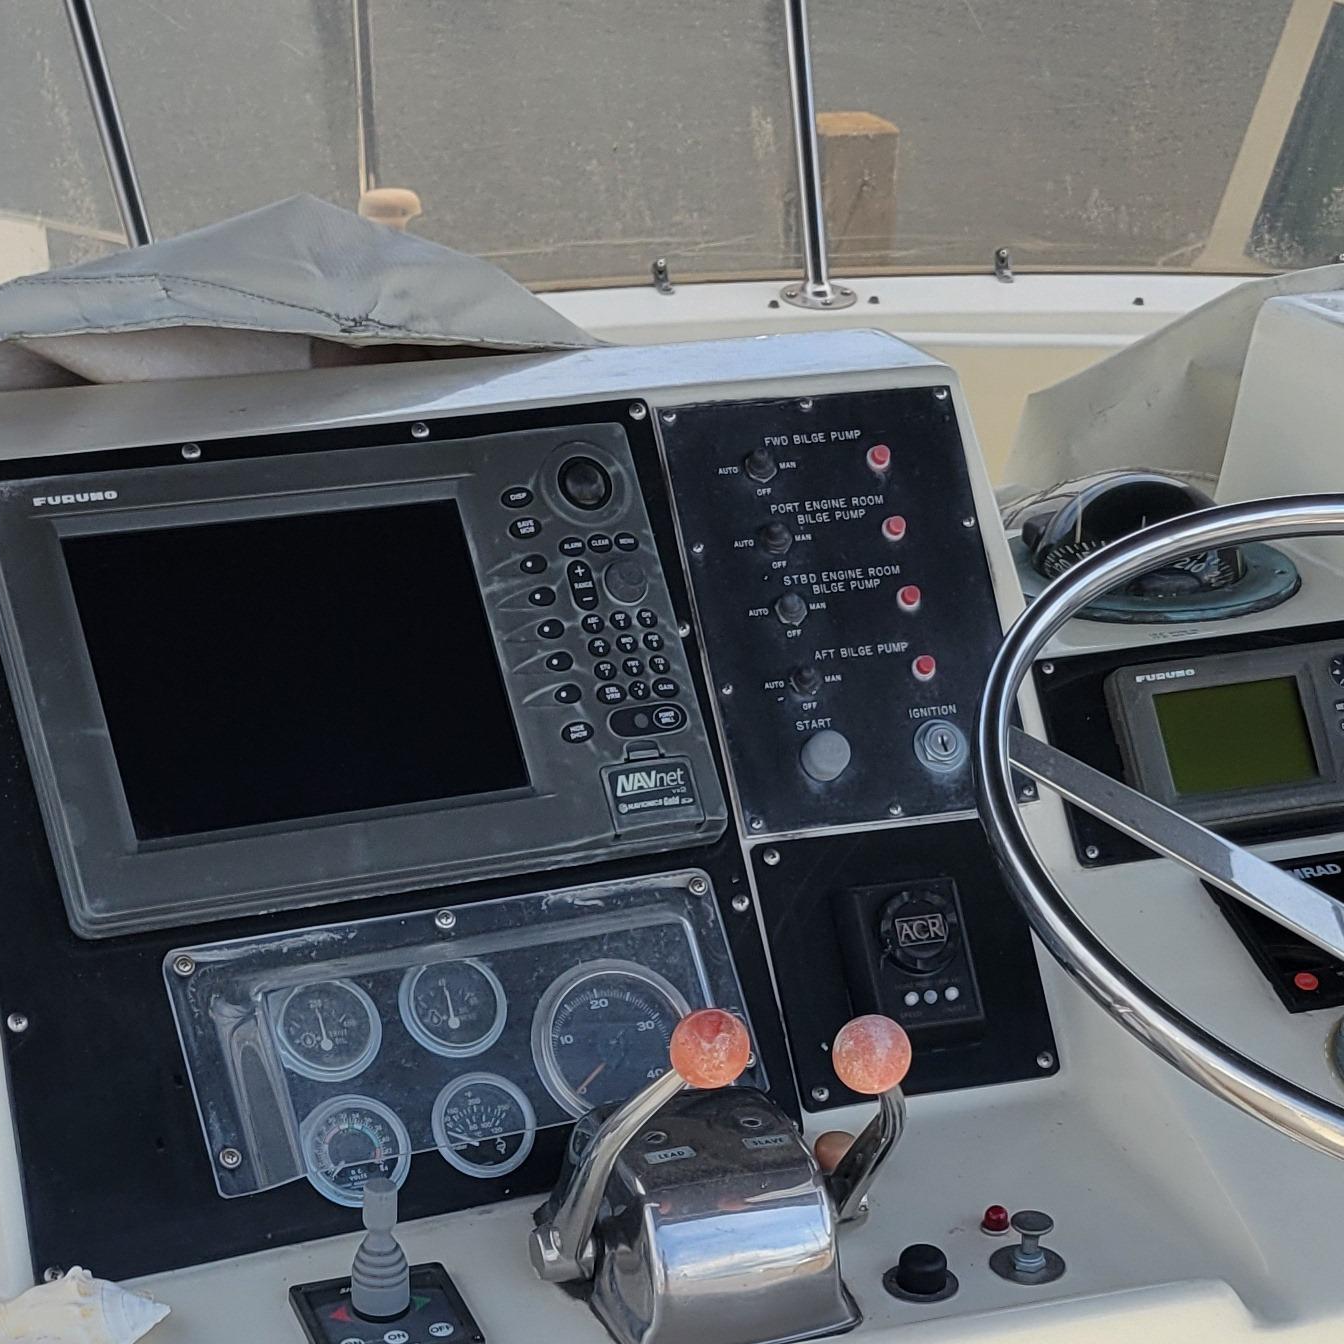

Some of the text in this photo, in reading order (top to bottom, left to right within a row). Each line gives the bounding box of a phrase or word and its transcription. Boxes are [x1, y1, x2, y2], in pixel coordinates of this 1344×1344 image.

[764, 430, 861, 446] FWD BILGE PUMP
[718, 467, 739, 475] AUTO
[756, 488, 772, 496] OFF
[32, 490, 118, 506] FURUNO
[770, 495, 884, 514] PORT ENGINE ROOM
[797, 509, 866, 524] BILGE PUMP
[591, 539, 609, 547] CLEAR
[771, 561, 787, 569] OFF
[1174, 558, 1206, 572] 210
[783, 565, 900, 585] STBD ENGINE ROOM
[812, 579, 881, 594] BILGE PUMP
[809, 602, 826, 610] MAN
[748, 608, 769, 616] AUTO
[787, 629, 802, 637] OFF
[814, 642, 909, 660] AFT BILGE PUMP
[1135, 669, 1195, 682] FURUNO
[764, 681, 785, 689] AUTO
[802, 702, 818, 710] OFF
[909, 705, 957, 718] IGNITION
[796, 718, 832, 731] START
[616, 768, 685, 797] NAVnet
[901, 919, 944, 941] ACR
[590, 999, 609, 1009] 20
[636, 1021, 655, 1031] 30
[559, 1035, 574, 1044] 10
[658, 1151, 685, 1159] LEAD
[430, 1325, 451, 1333] OFF
[387, 1333, 406, 1341] ON
